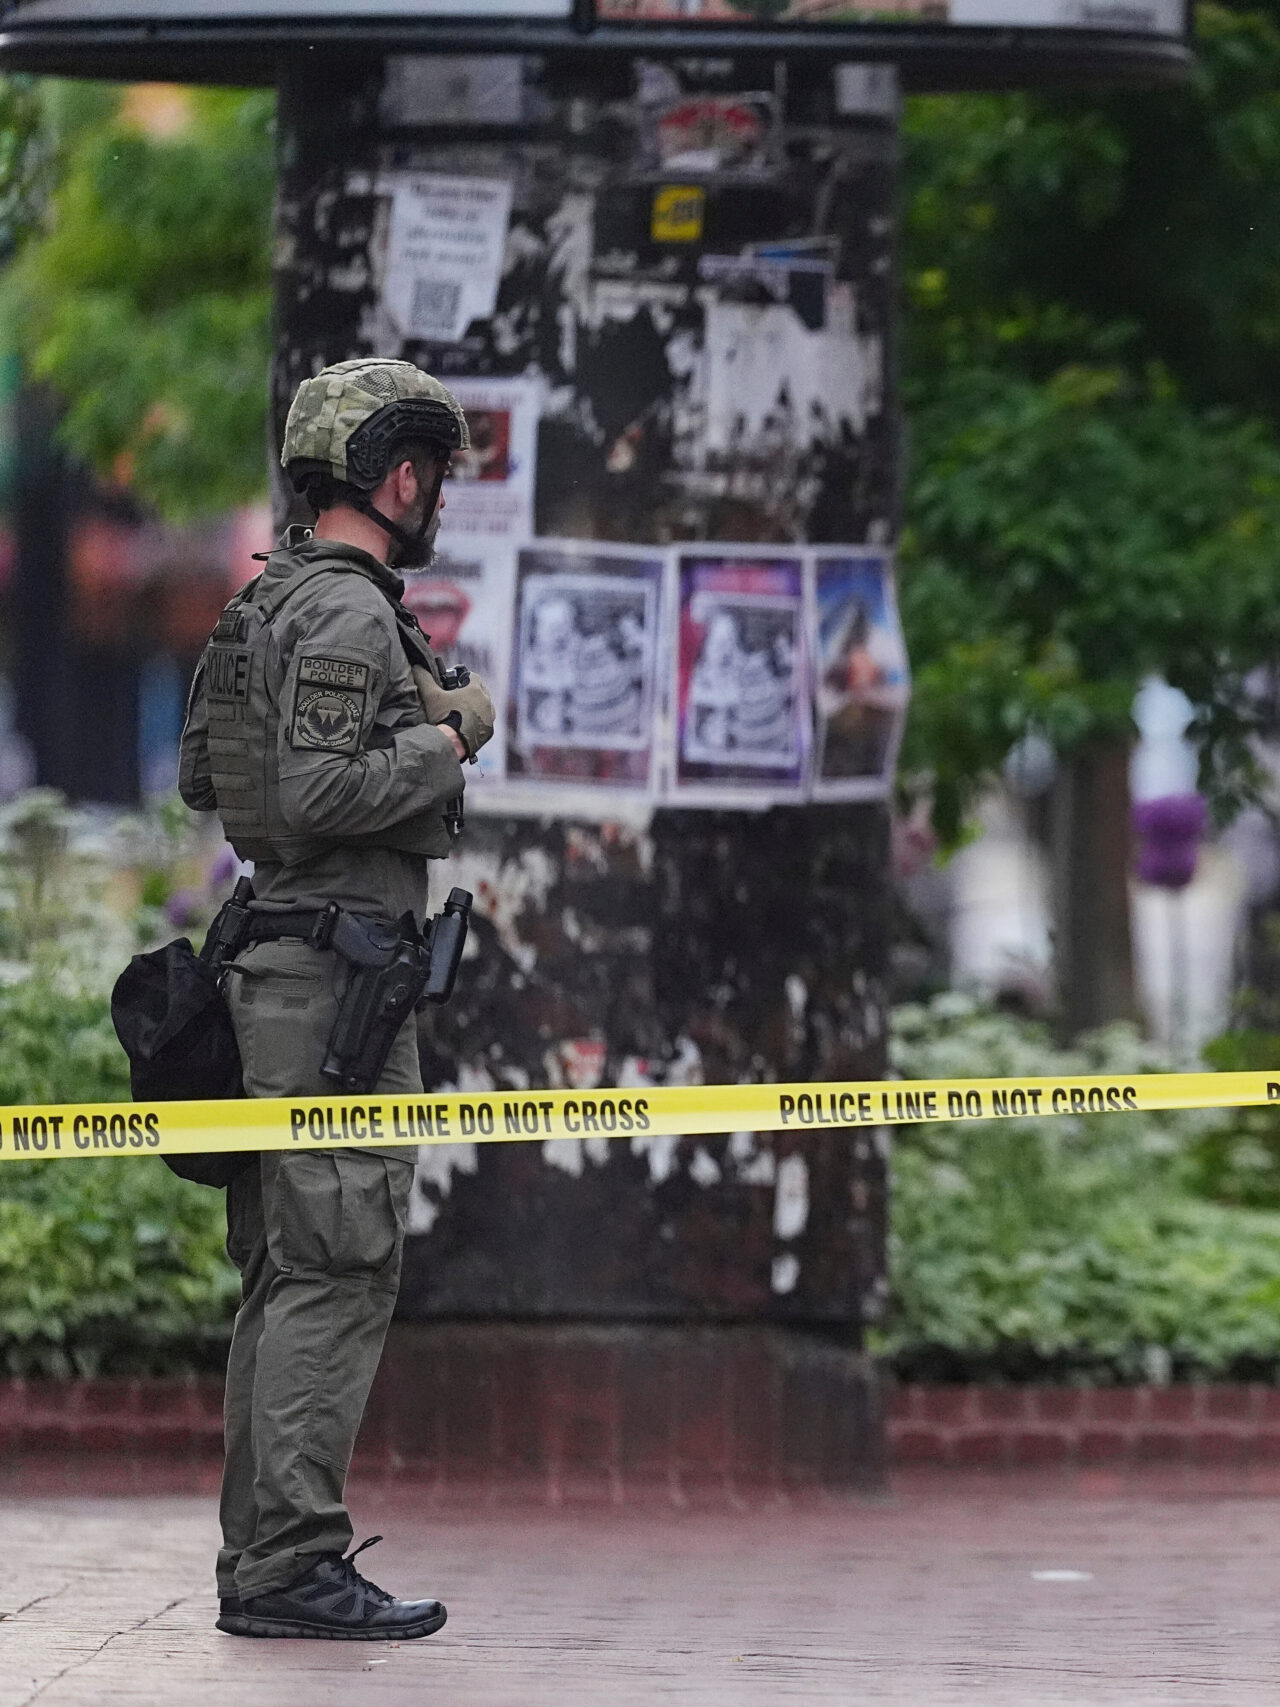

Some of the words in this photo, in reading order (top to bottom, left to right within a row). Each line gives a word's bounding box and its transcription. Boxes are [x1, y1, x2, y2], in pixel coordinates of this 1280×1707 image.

[304, 659, 363, 676] BOULDER
[310, 670, 355, 686] POLICE
[290, 1105, 384, 1141] POLICE
[392, 1104, 451, 1138] LINE
[459, 1102, 495, 1136] DO
[503, 1101, 554, 1134] NOT
[563, 1098, 651, 1132] CROSS
[779, 1092, 874, 1124] POLICE
[882, 1091, 939, 1121] LINE
[947, 1089, 983, 1118] DO
[992, 1088, 1043, 1116] NOT
[1052, 1086, 1138, 1113] CROSS
[13, 1115, 64, 1151] NOT
[73, 1112, 160, 1150] CROSS
